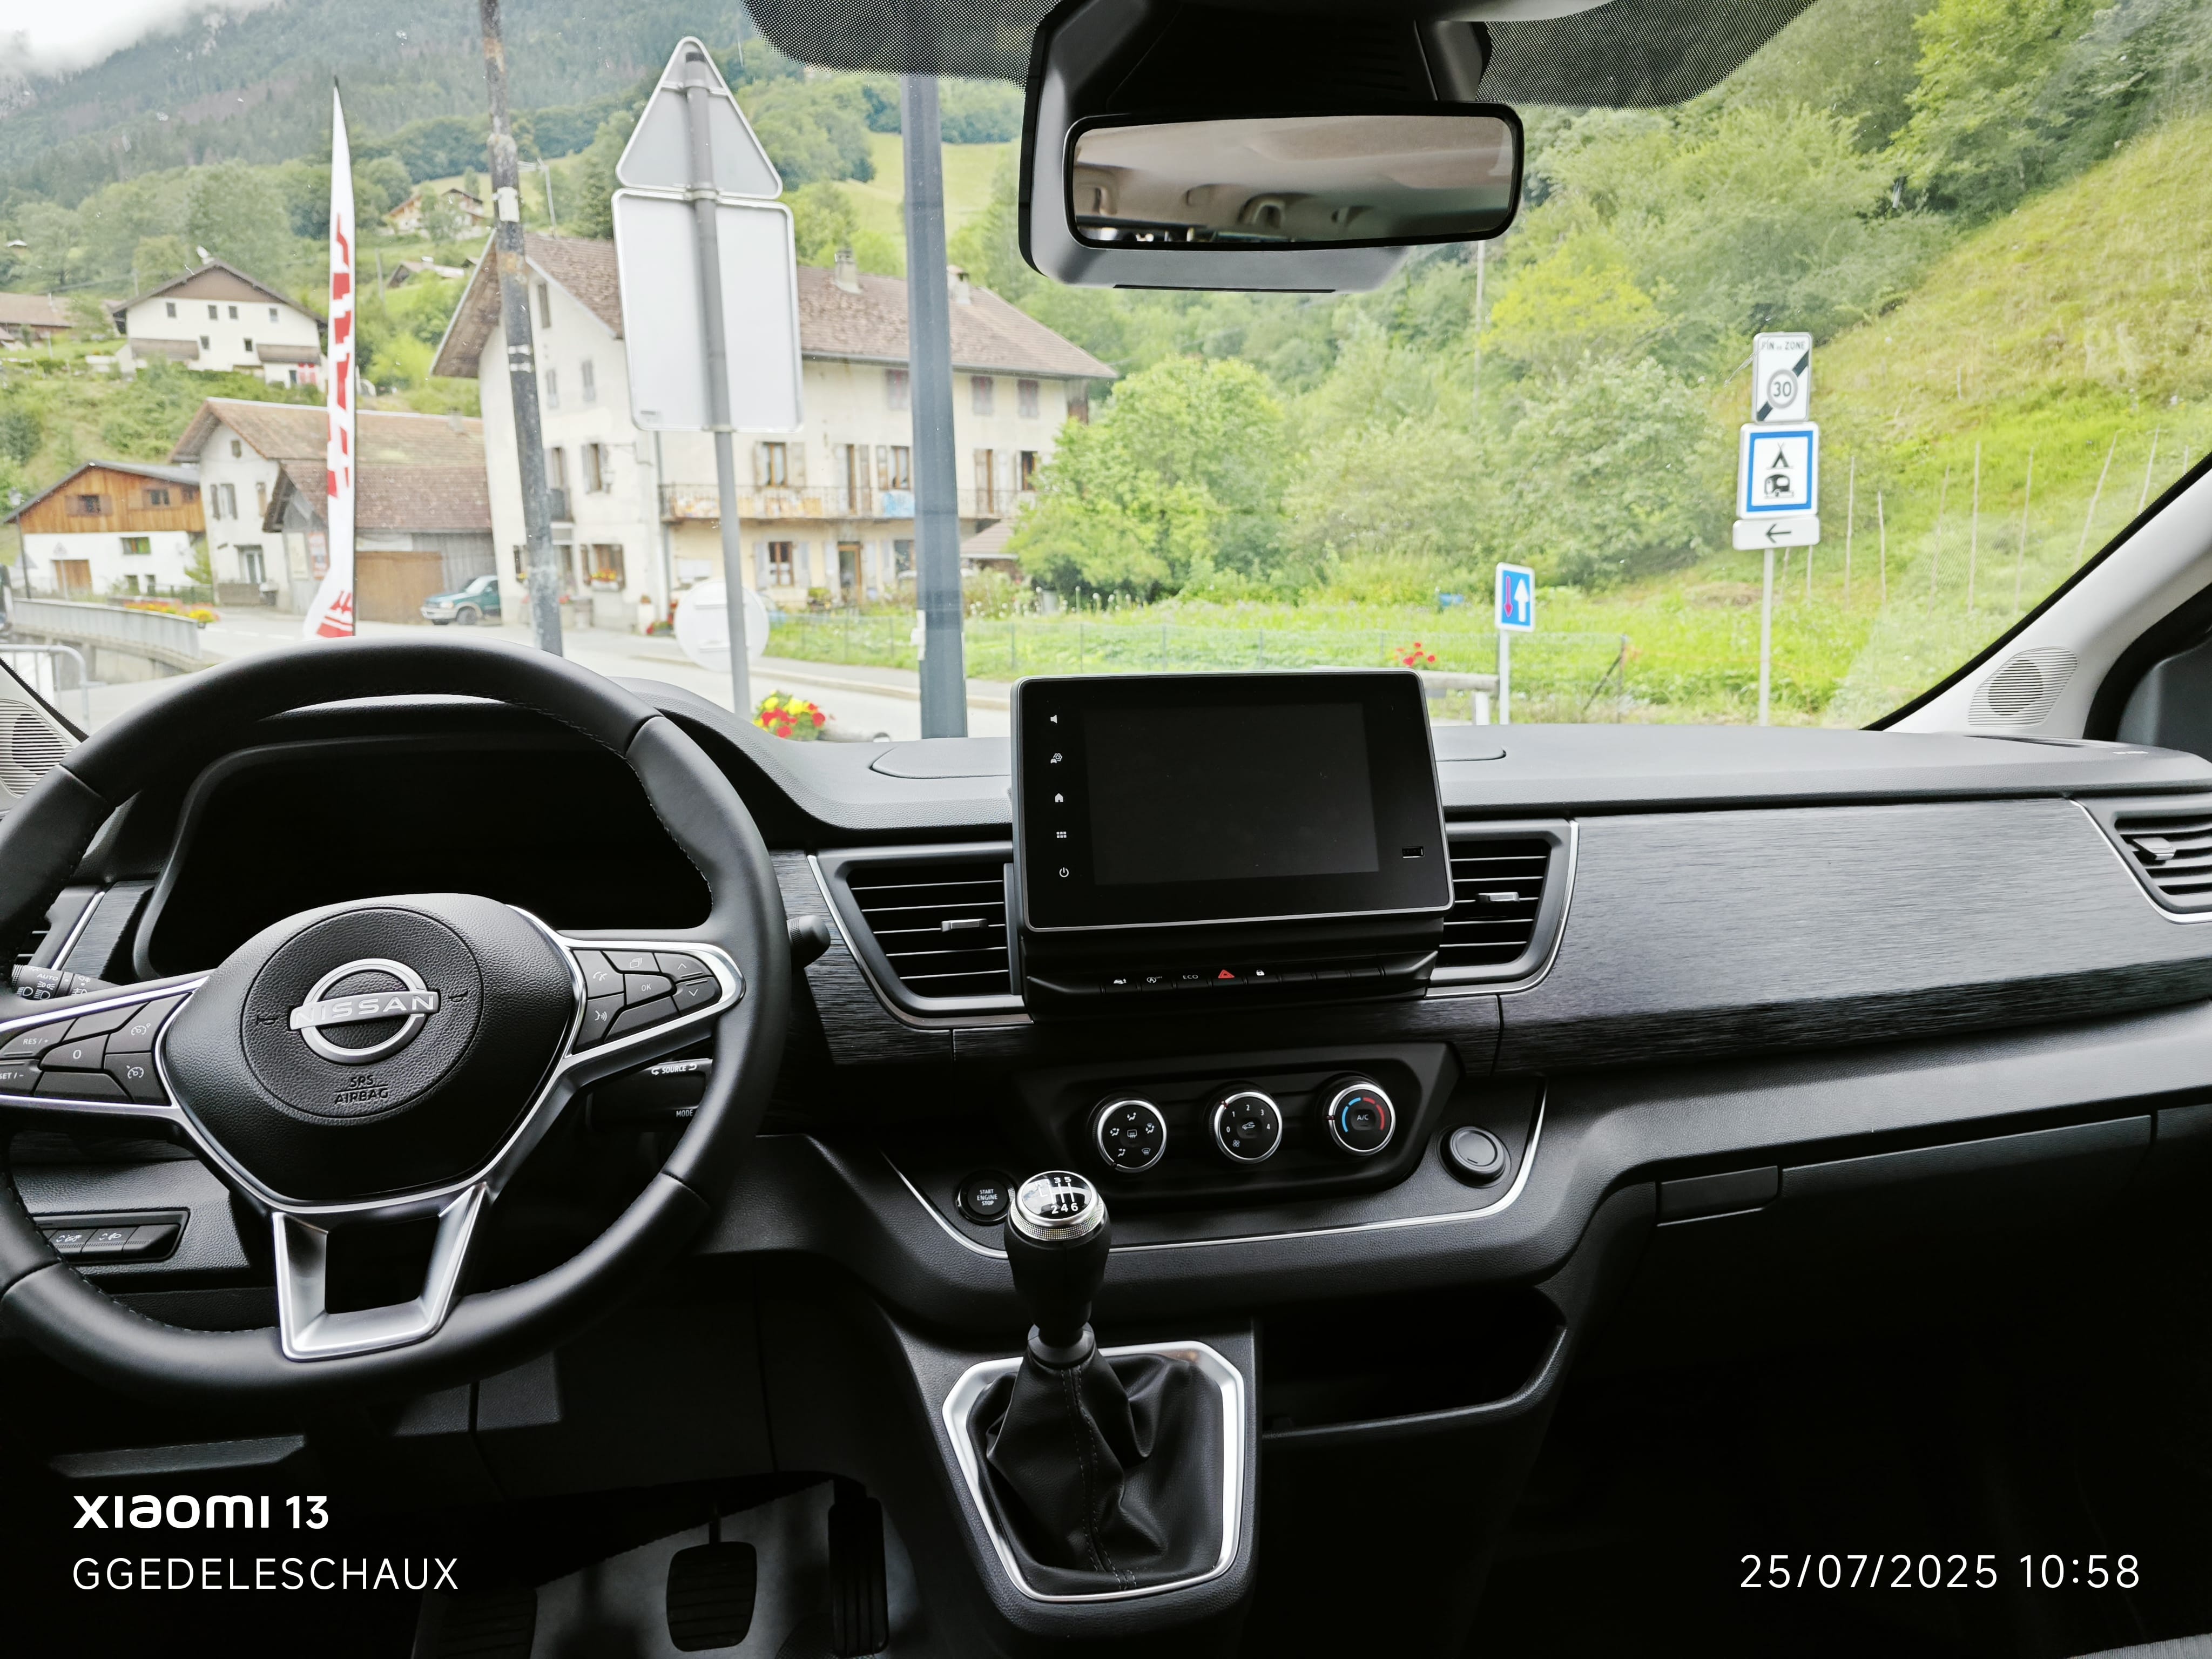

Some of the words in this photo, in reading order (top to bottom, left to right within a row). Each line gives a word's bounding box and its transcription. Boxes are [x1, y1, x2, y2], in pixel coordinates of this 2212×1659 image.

[1785, 341, 1805, 350] ZONE
[1773, 381, 1792, 397] 30
[37, 973, 58, 981] AUTO
[641, 983, 651, 992] OK
[295, 995, 434, 1026] NISSAN
[662, 1064, 686, 1074] SOURCE
[350, 1075, 374, 1088] SRS
[334, 1087, 389, 1105] AIRBAG
[676, 1109, 693, 1117] MODE
[1050, 1205, 1059, 1214] 2
[1061, 1203, 1069, 1212] 4
[1070, 1202, 1078, 1211] 6
